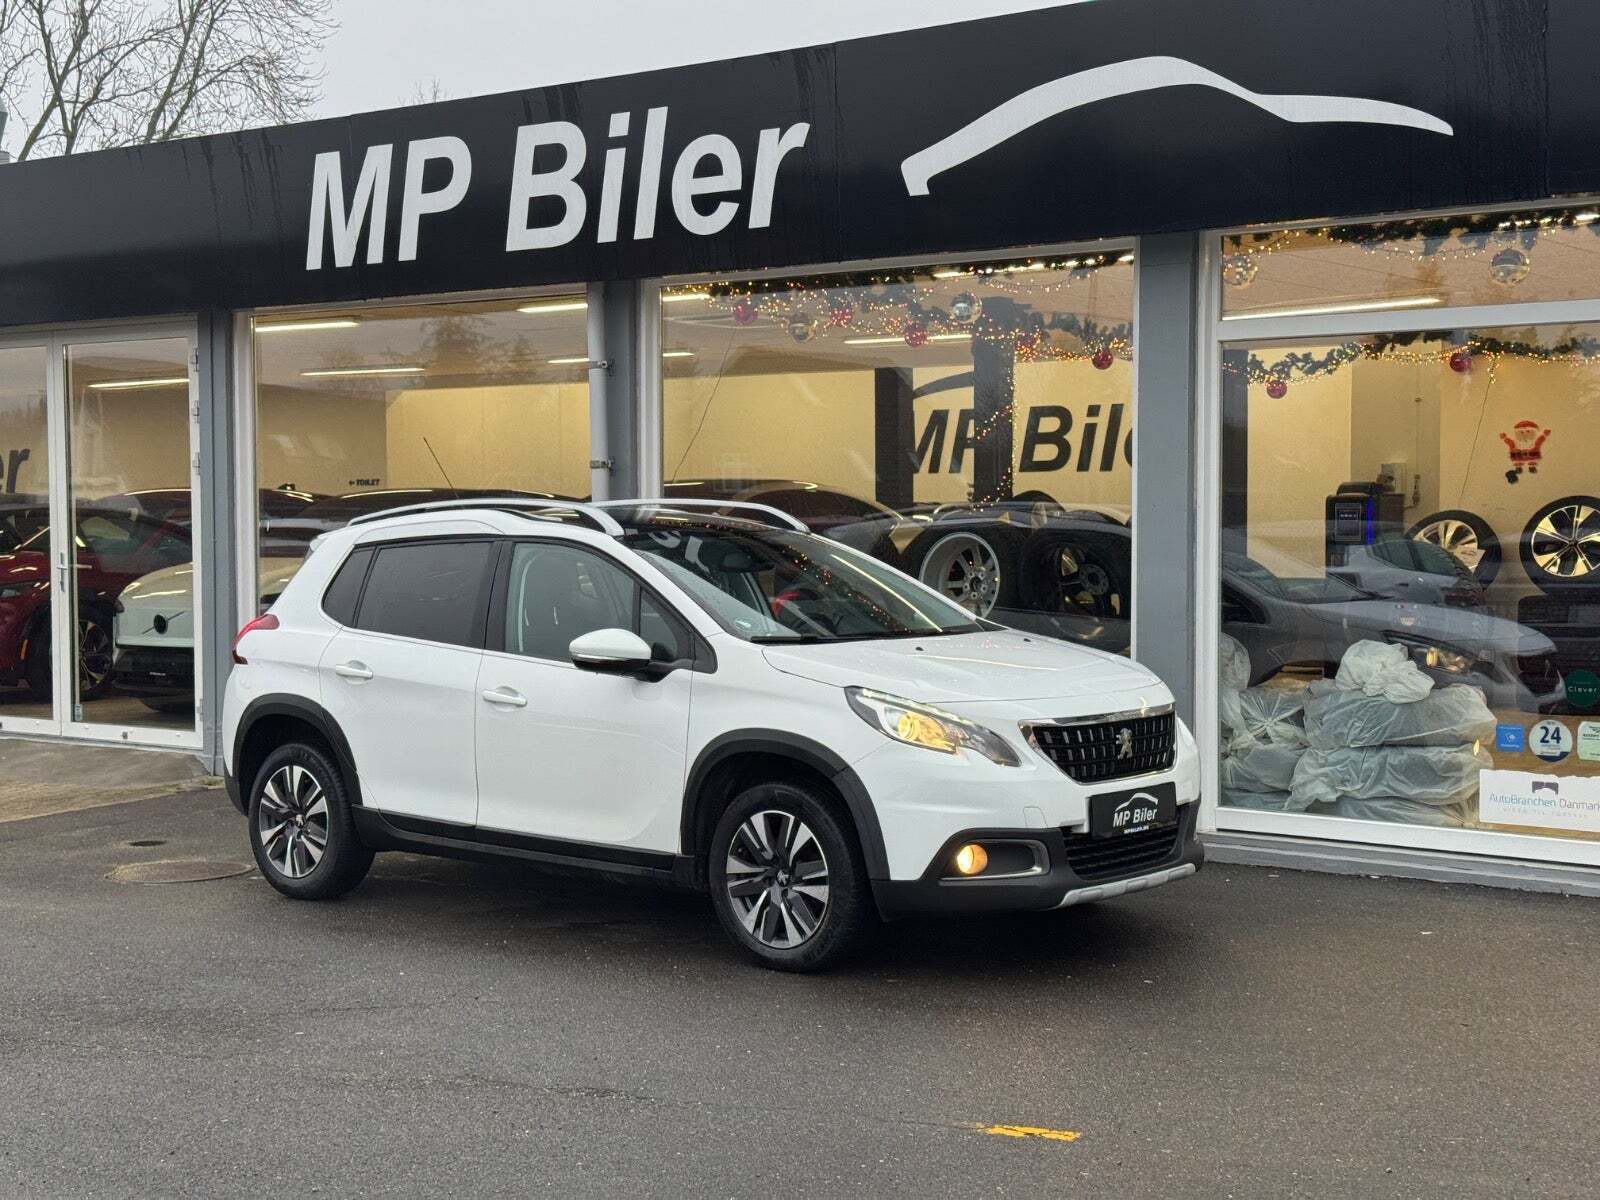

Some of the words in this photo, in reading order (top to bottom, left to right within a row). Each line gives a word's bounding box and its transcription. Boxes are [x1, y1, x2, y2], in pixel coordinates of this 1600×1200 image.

[306, 136, 472, 270] MP
[506, 106, 810, 252] Biler
[1019, 403, 1132, 472] Bil
[356, 478, 380, 486] TOILET
[1568, 685, 1597, 693] Clever
[1540, 726, 1562, 744] 24
[1489, 793, 1556, 807] AutoBranchen
[1113, 811, 1130, 827] MP
[1133, 807, 1157, 823] Biler
